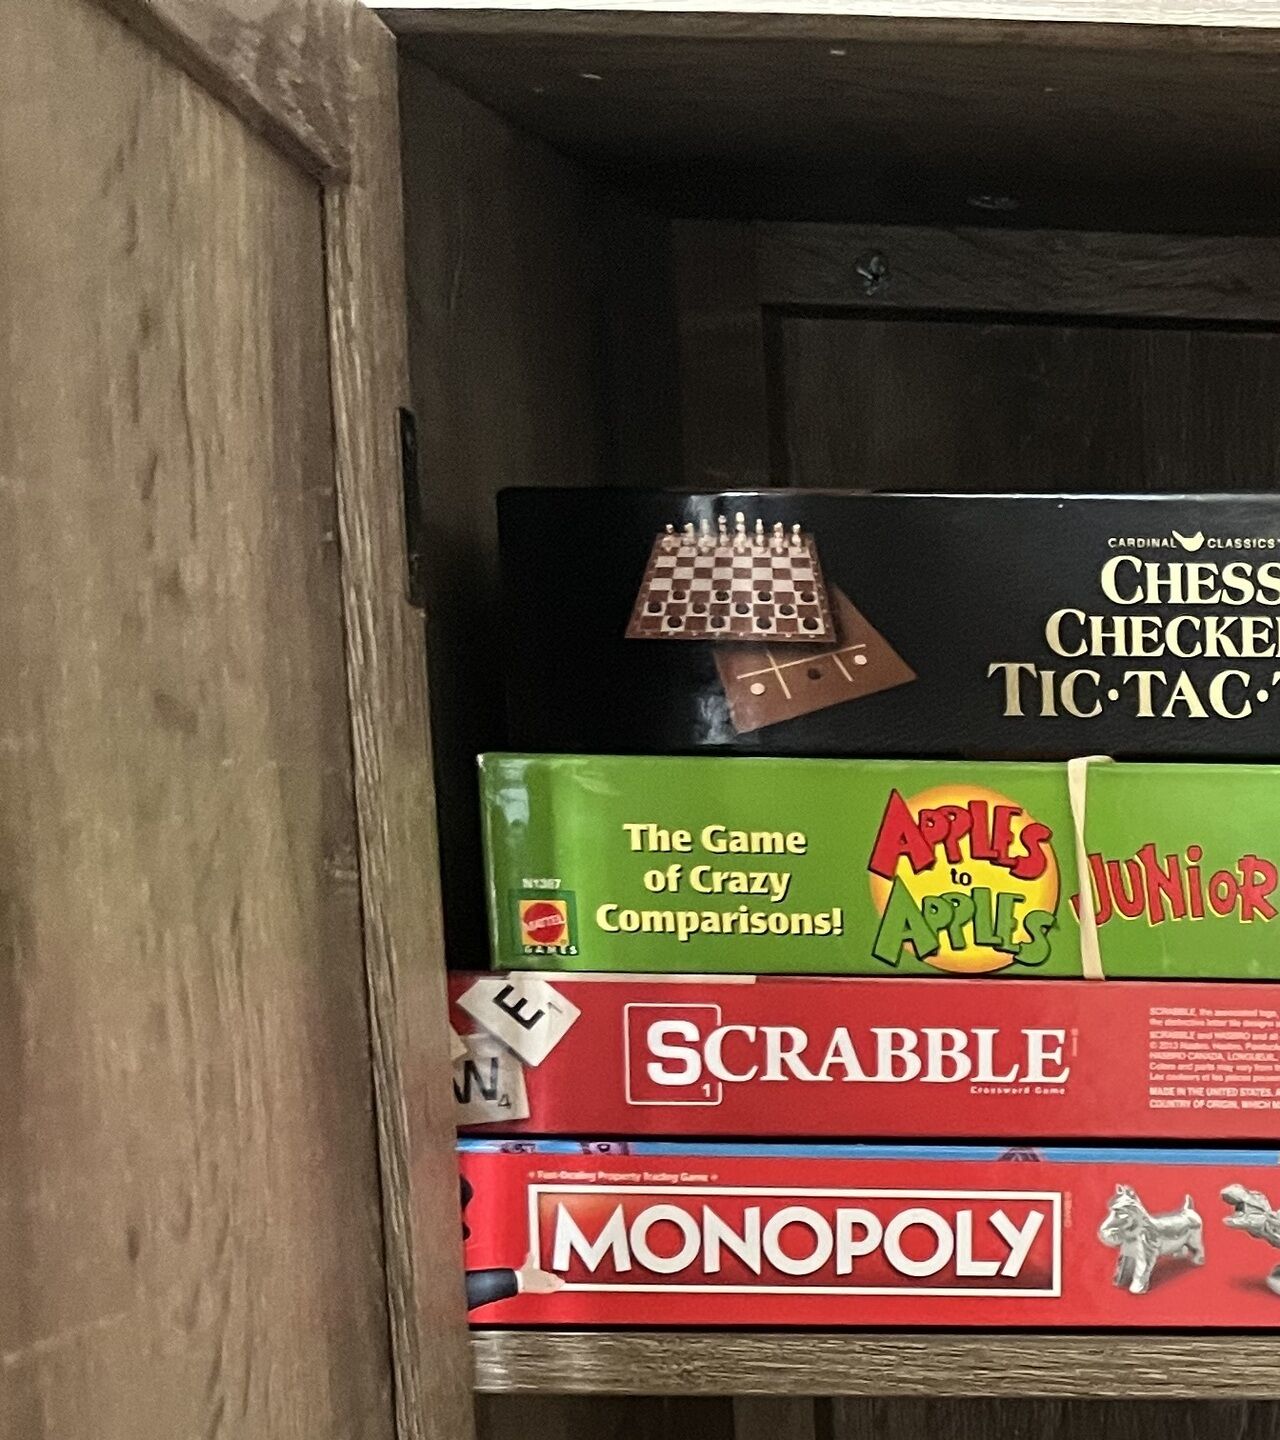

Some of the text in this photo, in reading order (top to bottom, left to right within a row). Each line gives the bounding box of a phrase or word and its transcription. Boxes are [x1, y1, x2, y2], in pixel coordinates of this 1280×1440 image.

[1108, 537, 1177, 549] CARDINAL
[623, 823, 807, 855] The Game
[868, 788, 1053, 879] APPLES
[644, 864, 792, 903] of Crazy
[949, 867, 973, 886] to
[596, 905, 844, 942] Comparisons!
[871, 877, 1057, 967] APPLES
[647, 1018, 1070, 1087] SCRABBLE
[552, 1203, 1045, 1278] MONOPOLY
